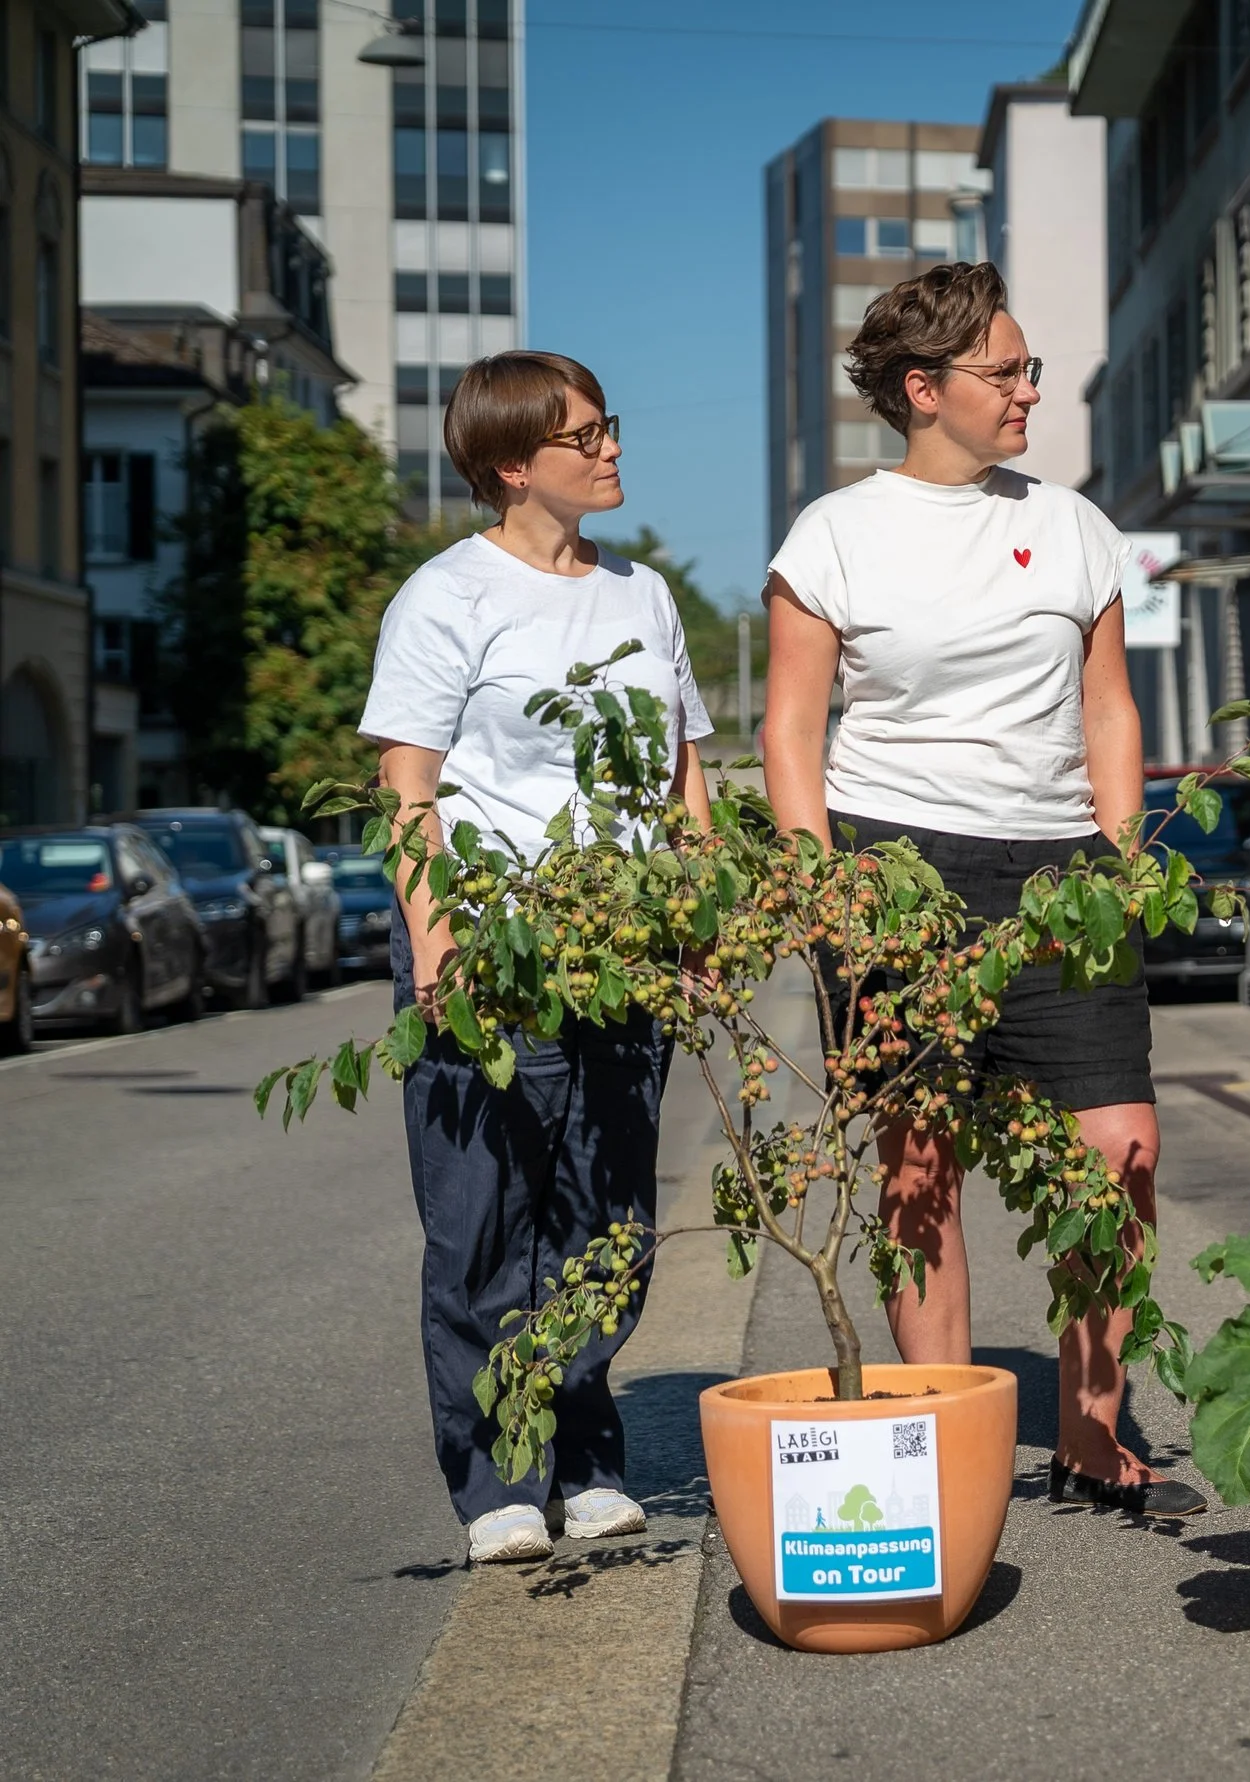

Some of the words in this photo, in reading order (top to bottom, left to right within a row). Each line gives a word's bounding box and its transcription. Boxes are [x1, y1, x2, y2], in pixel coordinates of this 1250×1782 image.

[781, 1450, 837, 1464] STADT
[785, 1538, 931, 1558] Klimaanpassung
[812, 1569, 842, 1585] on
[848, 1565, 906, 1585] Tour
